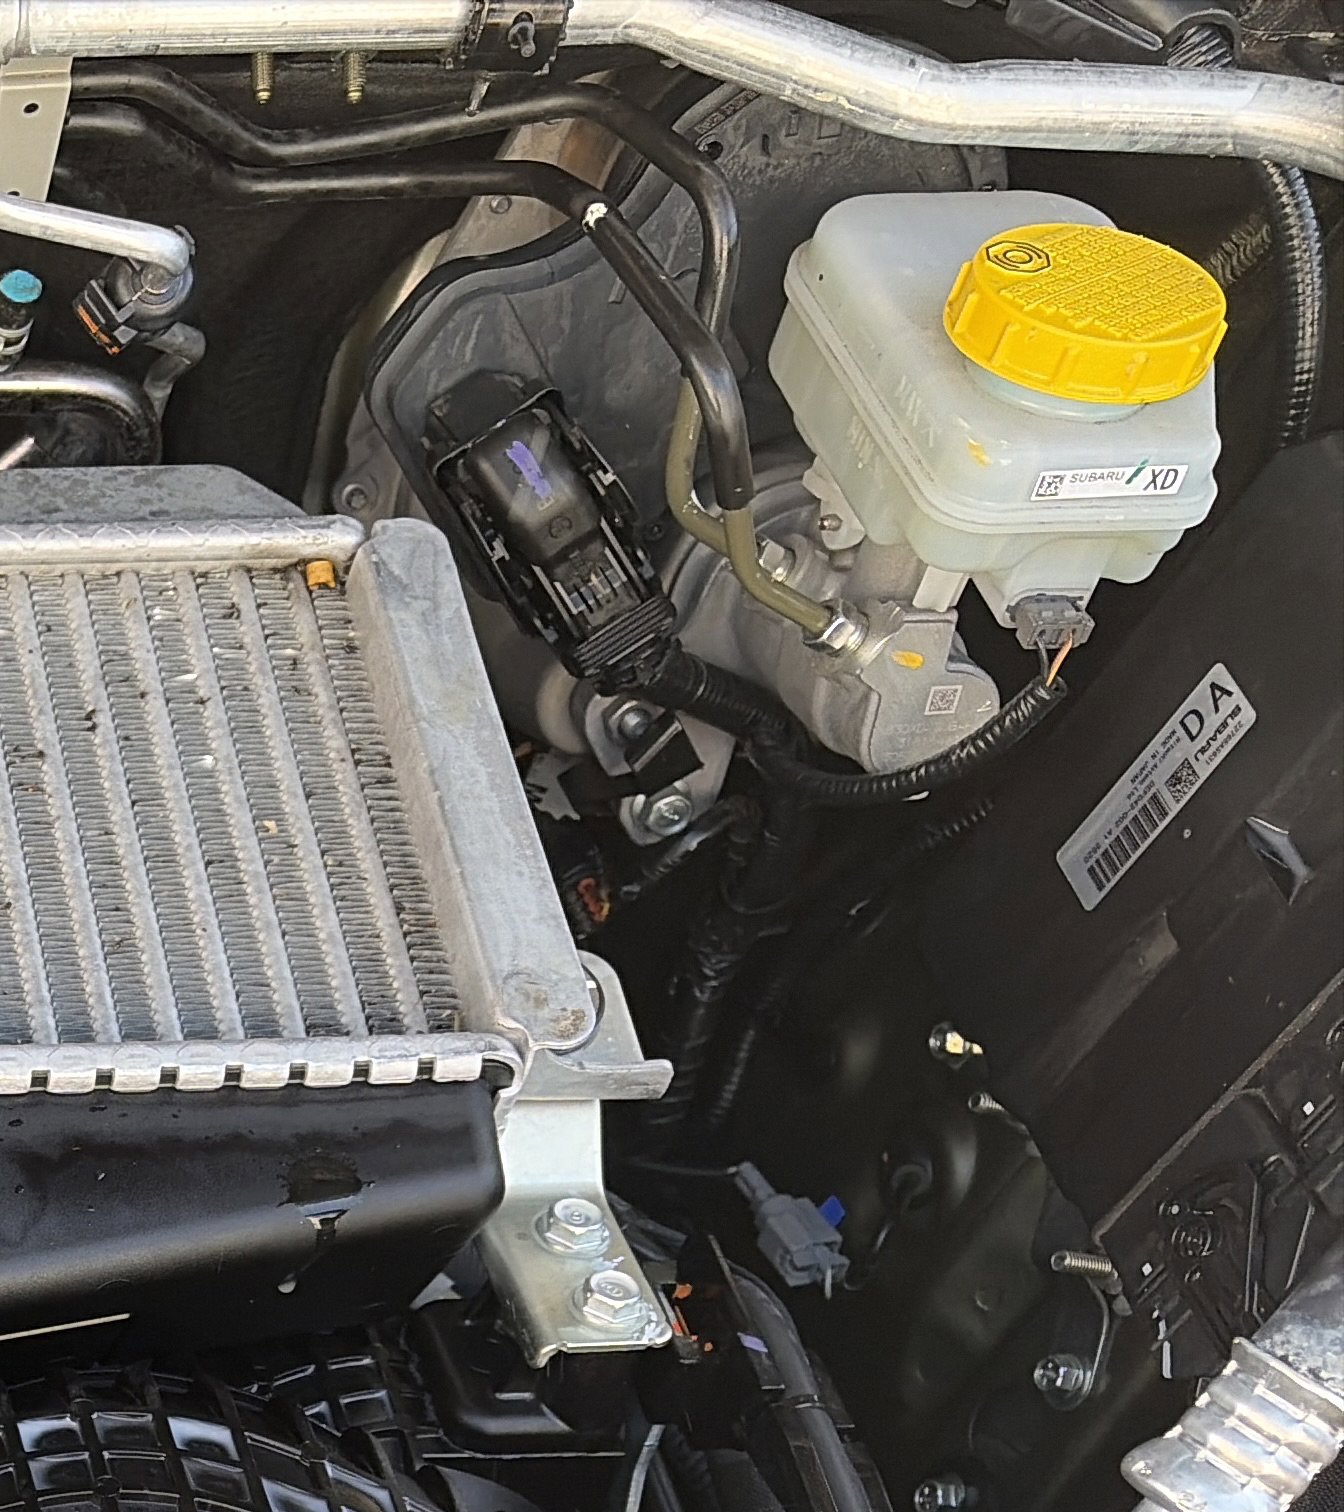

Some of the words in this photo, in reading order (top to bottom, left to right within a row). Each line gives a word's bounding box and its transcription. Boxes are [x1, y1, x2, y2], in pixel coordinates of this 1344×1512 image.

[1069, 471, 1126, 483] SUBARU
[1142, 468, 1179, 491] XD
[1160, 728, 1177, 749] MADE
[1192, 702, 1242, 763] SUBARU
[1130, 760, 1150, 785] JAPAN
